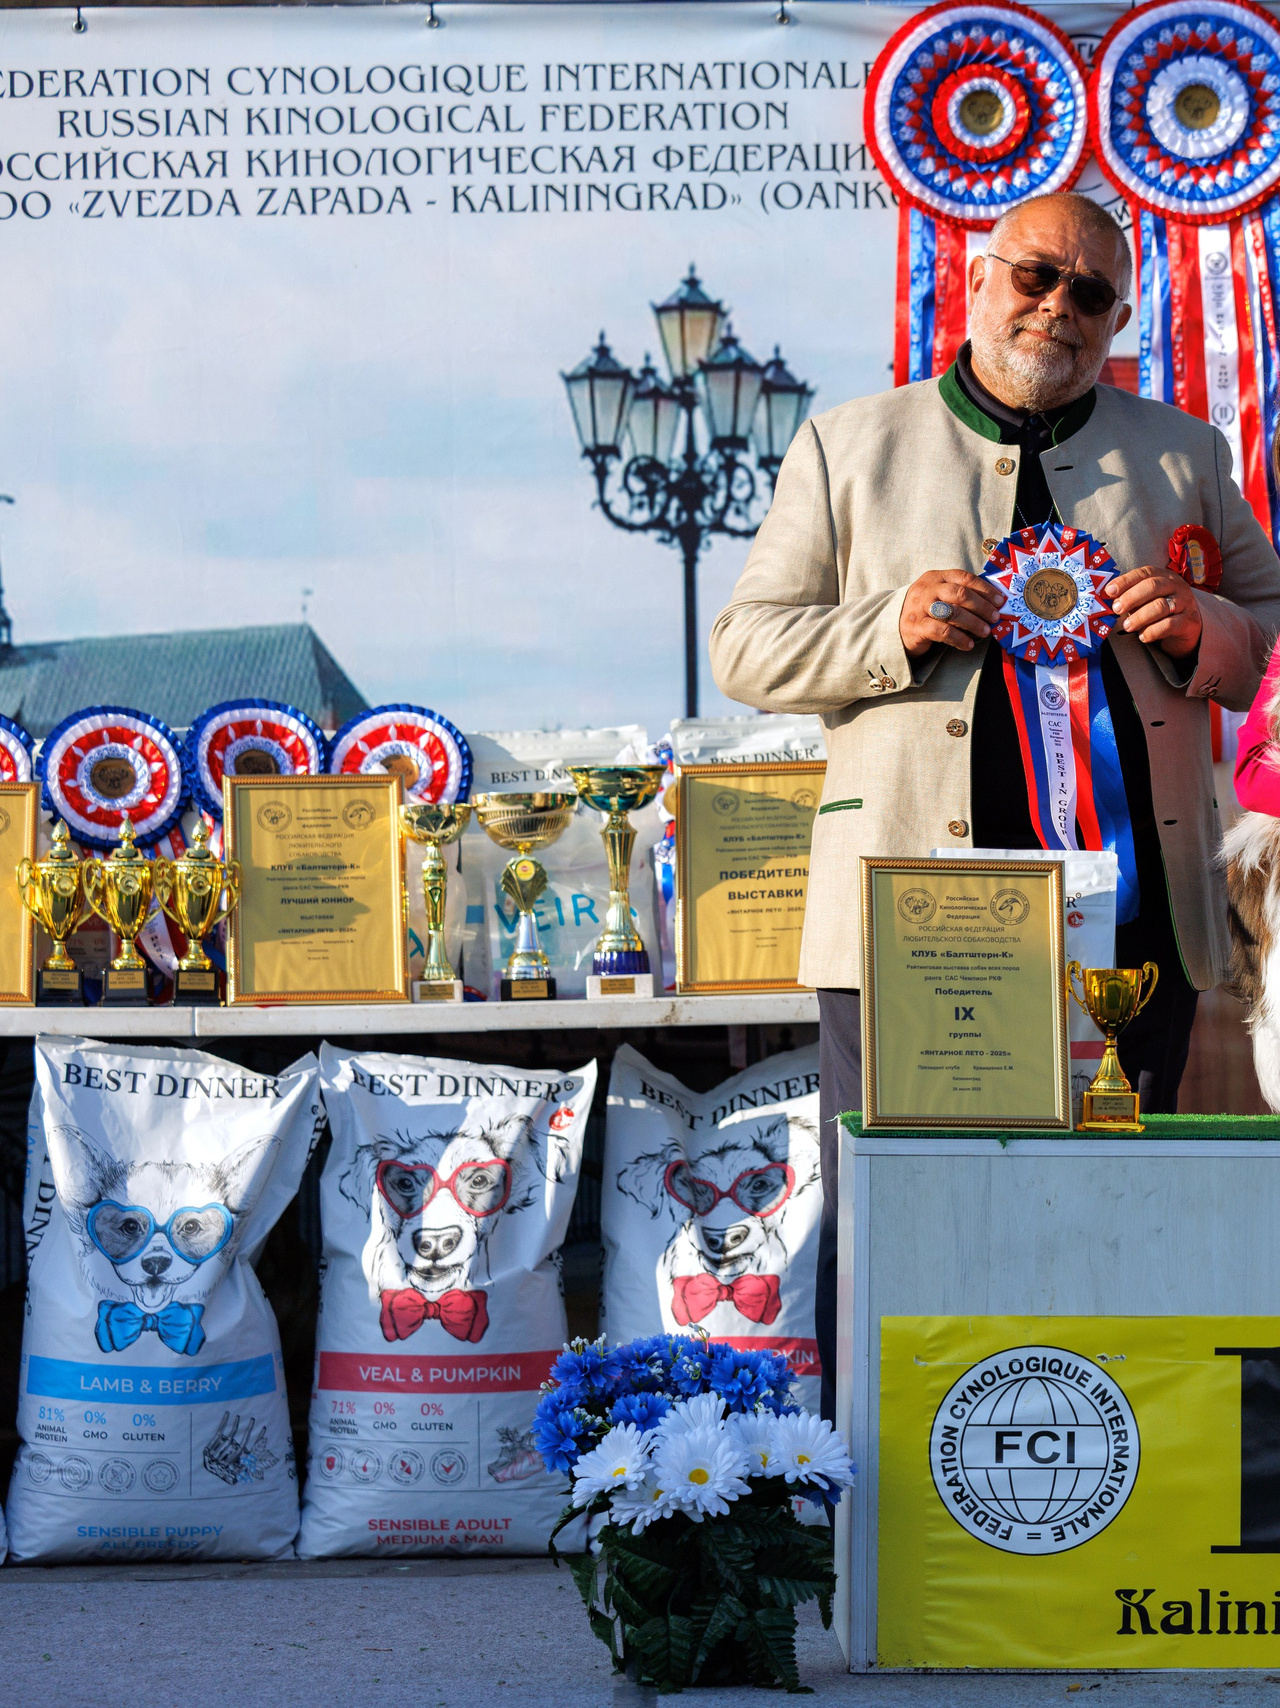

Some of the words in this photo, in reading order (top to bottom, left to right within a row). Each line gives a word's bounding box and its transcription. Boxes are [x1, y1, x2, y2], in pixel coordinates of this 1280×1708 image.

[0, 68, 209, 98] DERATION
[227, 62, 528, 98] CYNOLOGIQUE
[58, 108, 228, 138] RUSSIAN
[245, 105, 525, 137] KINOLOGICAL
[540, 101, 789, 134] FEDERATION
[0, 145, 228, 181] ССИЙСКАЯ
[246, 145, 638, 178] КИНОЛОГИЧЕСКАЯ
[652, 143, 886, 178] ФЕДЕРАЦИ
[69, 188, 242, 219] «ZVEZDA
[256, 186, 412, 216] ZAPADA
[452, 181, 742, 215] KALININGRAD»
[1055, 753, 1067, 777] BEST
[491, 769, 530, 785] BEST
[1058, 782, 1068, 795] IN
[728, 888, 803, 900] ВЫСТАВКИ
[911, 950, 937, 958] КЛУБ
[935, 987, 993, 996] Победитель
[954, 1007, 975, 1021] IX
[949, 1031, 982, 1039] группы
[62, 1062, 147, 1095] BEST
[154, 1073, 283, 1100] DINNER
[352, 1068, 428, 1098] BEST
[436, 1074, 562, 1102] DINNER
[640, 1078, 703, 1131] BEST
[359, 1366, 405, 1382] VEAL
[411, 1368, 424, 1382] &
[430, 1365, 521, 1383] PUMPKIN
[80, 1375, 134, 1393] LAMB
[140, 1379, 153, 1393] &
[158, 1376, 223, 1394] BERRY
[949, 1356, 1093, 1420] CYNOLOGIQUE
[38, 1405, 65, 1423] 81%
[84, 1410, 107, 1425] 0%
[133, 1413, 156, 1428] 0%
[331, 1401, 357, 1415] 71%
[374, 1401, 395, 1415] 0%
[420, 1402, 444, 1416] 0%
[36, 1423, 67, 1434] ANIMAL
[373, 1420, 397, 1430] GMO
[411, 1422, 453, 1431] GLUTEN
[34, 1431, 68, 1443] PROTEIN
[83, 1430, 108, 1441] GMO
[122, 1432, 165, 1442] GLUTEN
[994, 1430, 1076, 1464] FCI
[1050, 1382, 1130, 1543] INTERNATIONALE
[940, 1425, 1014, 1541] FEDERATION
[77, 1525, 160, 1538] SENSIBLE
[165, 1525, 223, 1537] PUPPY
[368, 1519, 449, 1531] SENSIBLE
[455, 1518, 512, 1530] ADULT
[377, 1534, 444, 1545] MEDIUM
[449, 1535, 460, 1544] &
[464, 1534, 503, 1544] MAXI
